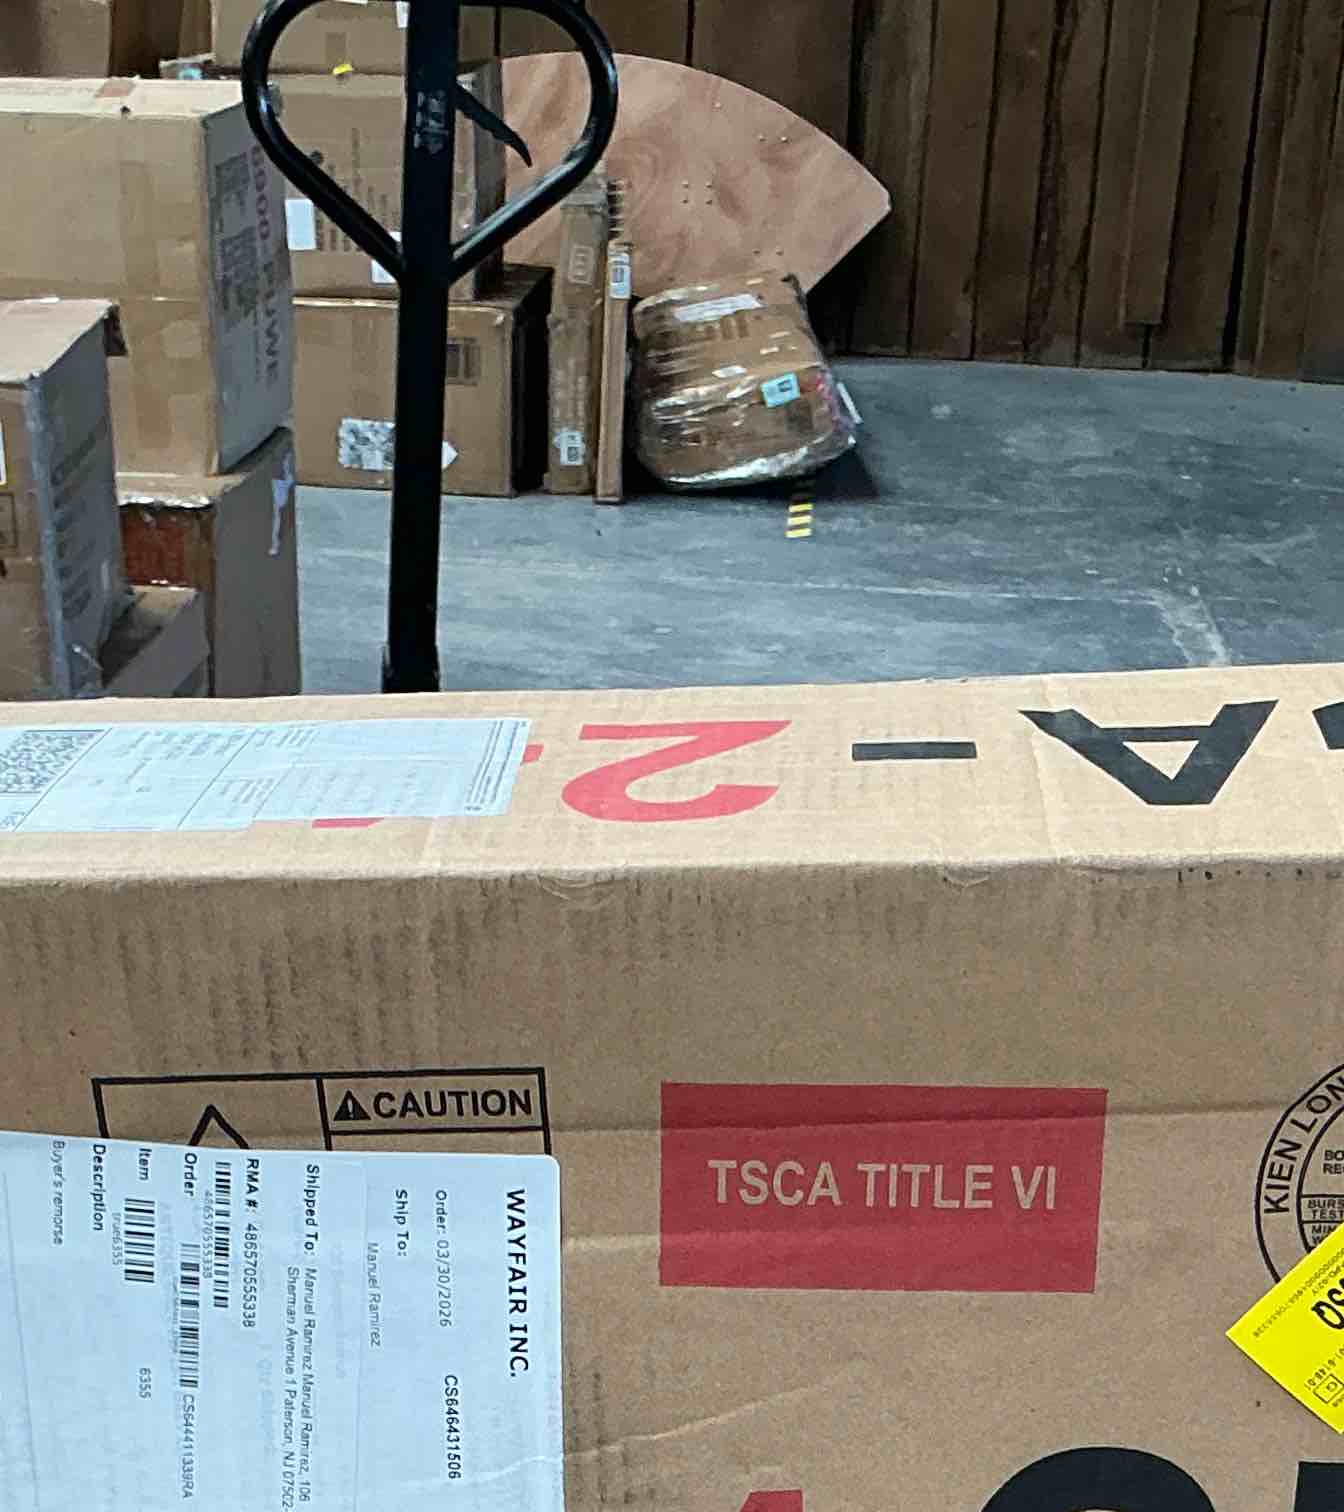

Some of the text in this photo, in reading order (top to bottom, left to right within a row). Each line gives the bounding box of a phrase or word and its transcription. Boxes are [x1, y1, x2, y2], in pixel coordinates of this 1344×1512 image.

[372, 1089, 532, 1120] CAUTION
[52, 1191, 65, 1245] remorse
[90, 1144, 106, 1231] Description
[184, 1153, 197, 1197] Order
[303, 1164, 320, 1255] Shipped To:
[707, 1160, 1057, 1210] TSCA TITLE VI
[1263, 1138, 1303, 1214] KIEN
[242, 1159, 259, 1328] RMA 486570555338
[393, 1189, 409, 1256] Ship To:
[435, 1190, 452, 1327] Order: 03/30/2026
[139, 1148, 152, 1400] Item 6355
[286, 1266, 300, 1322] Sherman
[366, 1242, 383, 1347] Manuel Ramirez
[507, 1188, 528, 1377] WAYFAIR INC.
[299, 1268, 317, 1501] Manuel Manuel 106
[444, 1374, 461, 1479] CS646431506
